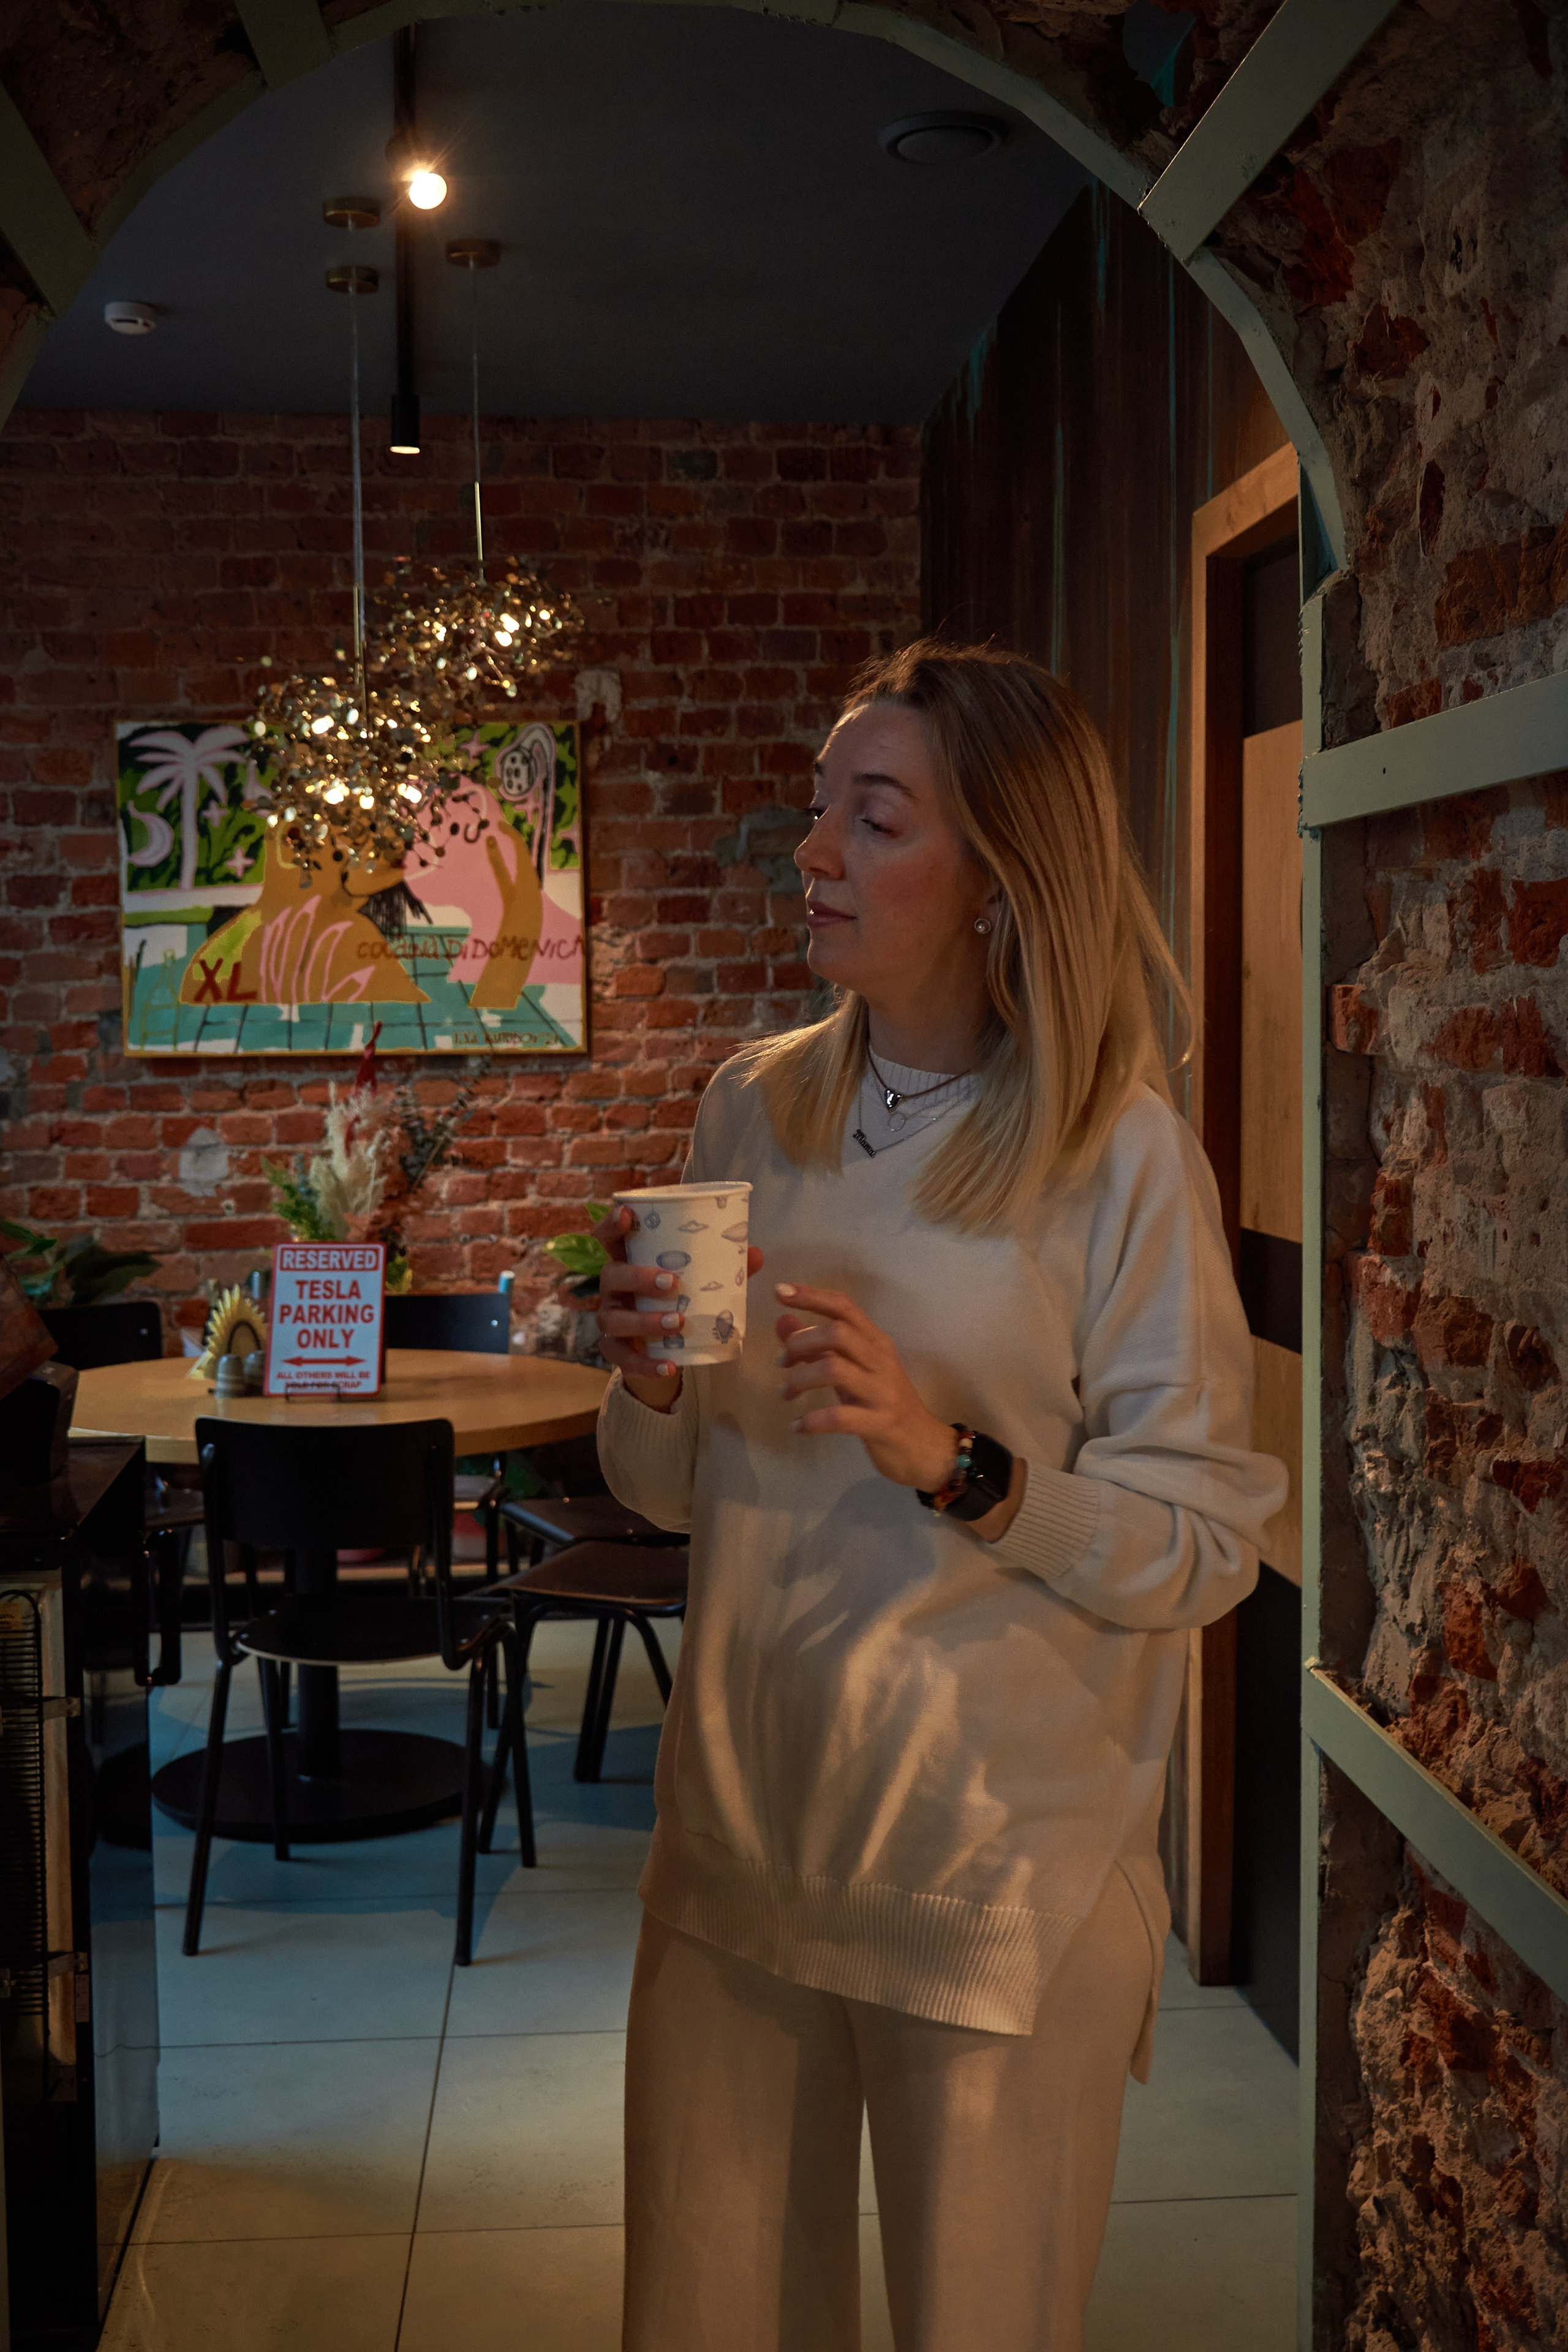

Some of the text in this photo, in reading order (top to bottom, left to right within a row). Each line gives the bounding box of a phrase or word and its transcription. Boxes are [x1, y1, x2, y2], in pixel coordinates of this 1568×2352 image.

[194, 957, 258, 1002] XL
[282, 1250, 376, 1269] RESERVED
[295, 1280, 361, 1300] TESLA
[279, 1304, 374, 1324] PARKING
[296, 1329, 355, 1349] ONLY
